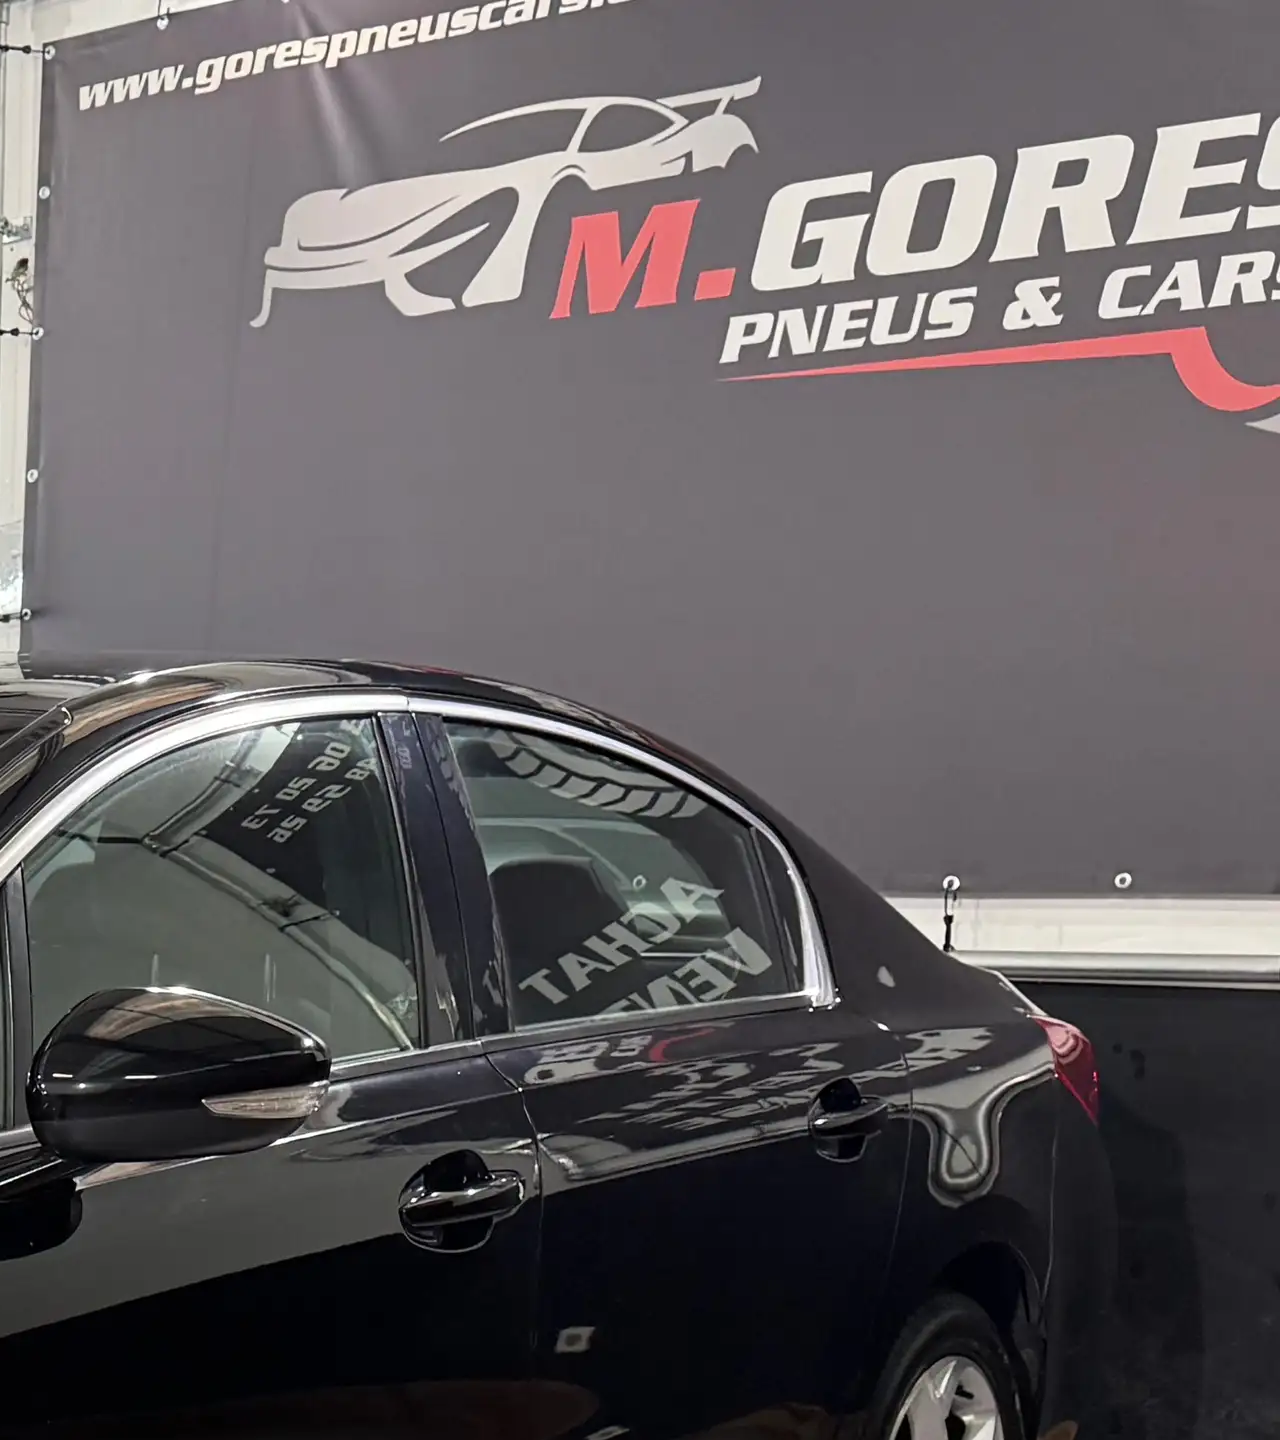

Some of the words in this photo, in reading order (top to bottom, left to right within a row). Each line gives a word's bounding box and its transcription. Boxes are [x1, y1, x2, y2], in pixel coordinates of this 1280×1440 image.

[719, 286, 978, 364] PNEUS
[1002, 276, 1064, 331] &
[1097, 250, 1280, 319] CAR
